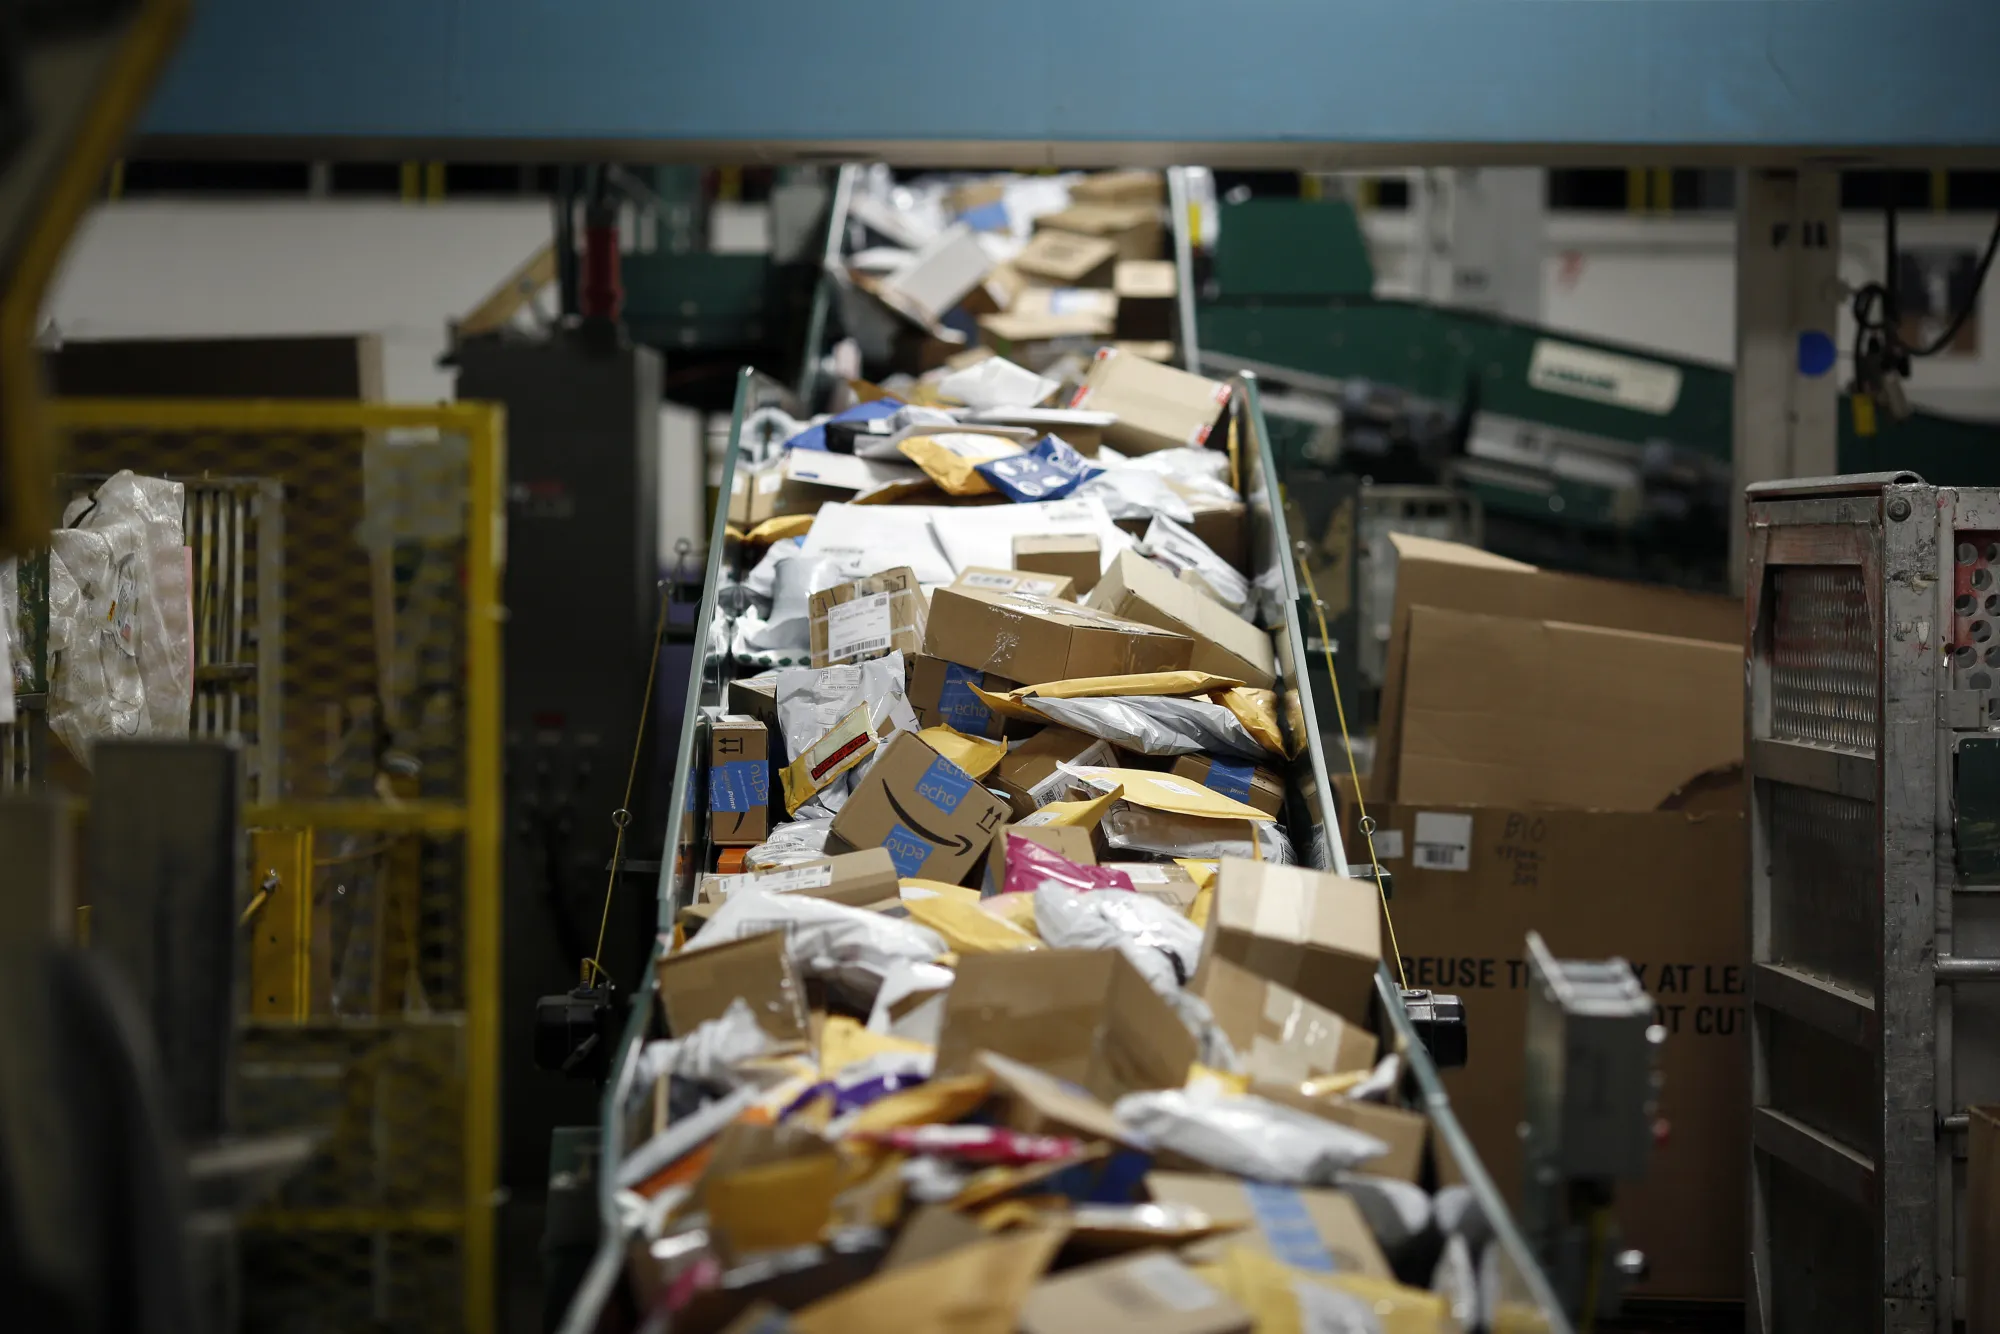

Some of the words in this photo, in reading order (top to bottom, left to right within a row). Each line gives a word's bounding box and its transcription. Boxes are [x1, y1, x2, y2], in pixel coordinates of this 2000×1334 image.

[955, 702, 988, 718] echo
[750, 764, 768, 801] echo
[918, 782, 957, 806] echo
[886, 838, 925, 860] echo
[1396, 956, 1495, 987] REUSE
[1505, 959, 1529, 988] T
[1657, 963, 1694, 992] AT
[1704, 965, 1745, 993] LE
